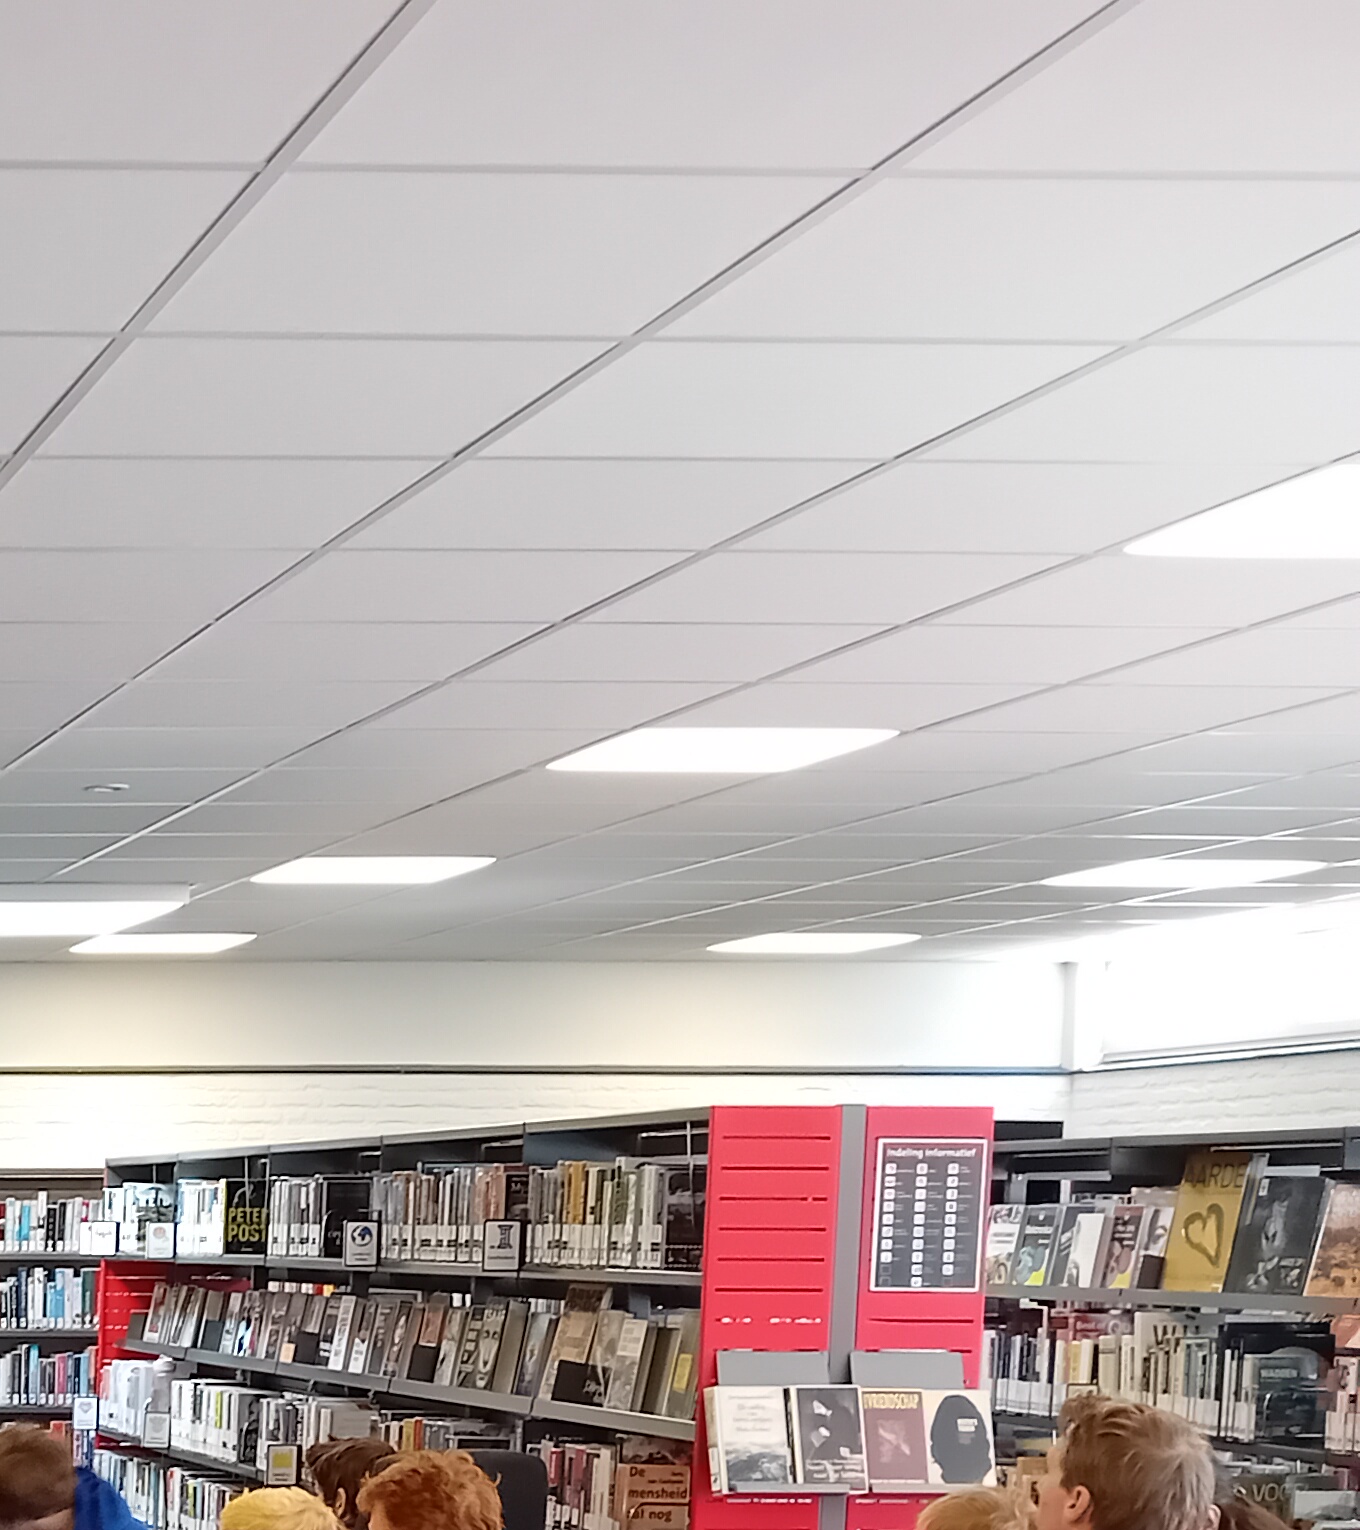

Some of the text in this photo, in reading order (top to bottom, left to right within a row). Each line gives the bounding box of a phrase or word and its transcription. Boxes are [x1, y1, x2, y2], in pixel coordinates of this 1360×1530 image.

[886, 1148, 923, 1159] Indeling
[1184, 1163, 1247, 1188] AARDE
[629, 1466, 646, 1477] De
[628, 1487, 687, 1499] mensheid
[649, 1510, 672, 1522] nog
